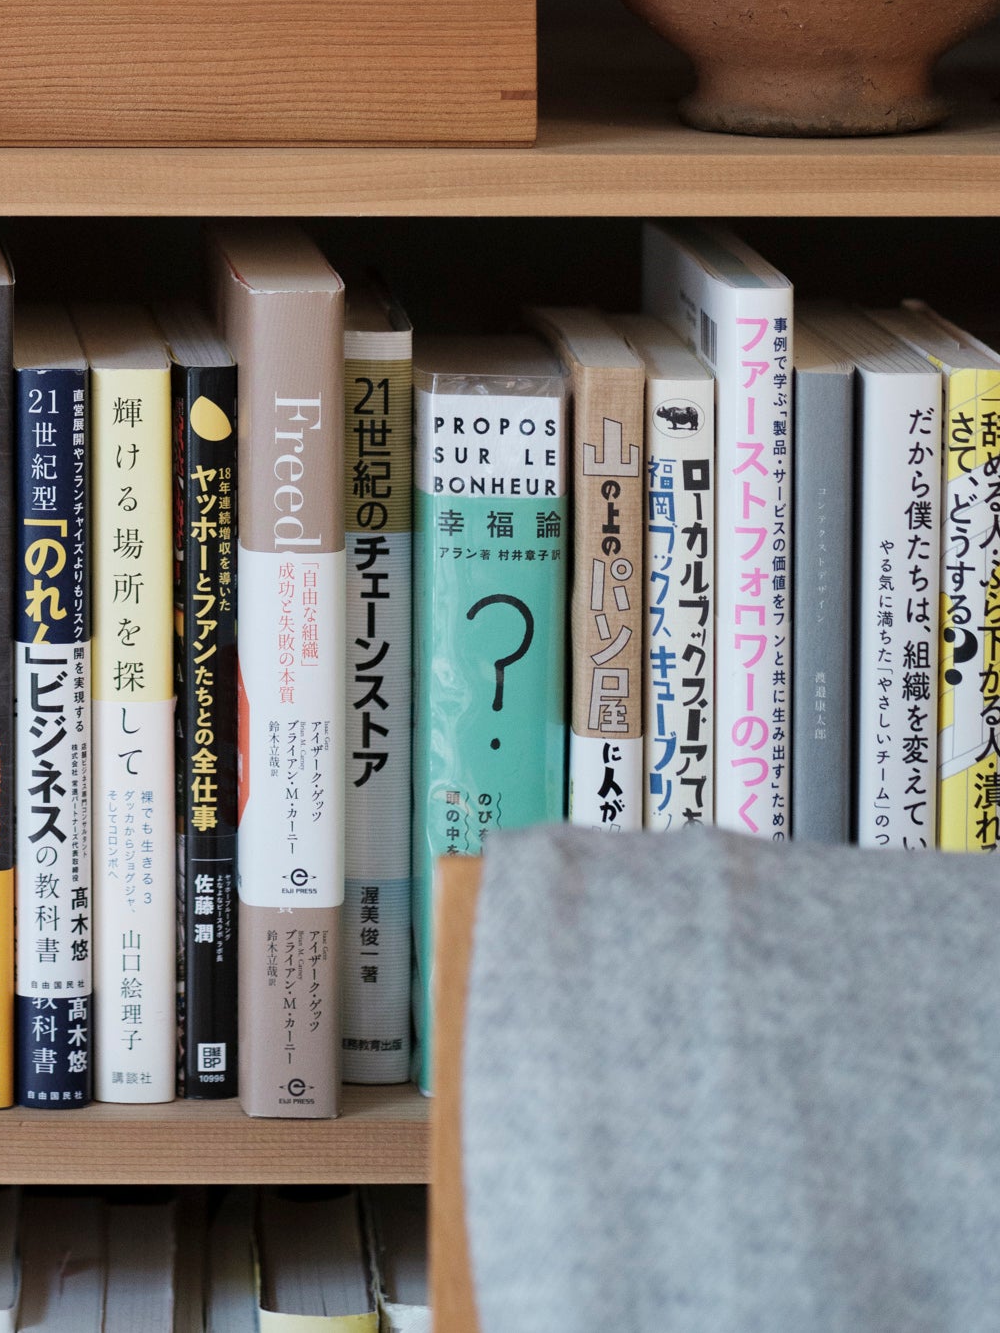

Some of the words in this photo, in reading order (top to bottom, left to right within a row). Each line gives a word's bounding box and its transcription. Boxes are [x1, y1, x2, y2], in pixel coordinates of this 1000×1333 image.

[274, 391, 322, 551] Freed
[433, 446, 491, 465] SUR
[525, 449, 556, 466] LE
[434, 417, 556, 436] PROPOS
[433, 476, 557, 496] BONHEUR
[438, 510, 562, 538] 幸福論
[111, 396, 145, 775] 輝ける場所を探して
[218, 468, 231, 612] 18年連続増収を導いた
[352, 378, 394, 788] 21世紀のチェーンストア
[731, 317, 771, 834] ファーストフォロワーのつく
[190, 464, 219, 832] ヤッホーとファンたちとの全仕事
[277, 562, 295, 705] 成功と失敗の本質
[300, 562, 320, 667] 「自由な組織」
[267, 721, 280, 767] 鈴木立哉
[286, 720, 300, 854] ブライアン・M・カーニー
[310, 720, 325, 822] アイザーク・ゲッツ
[106, 790, 120, 880] そしてコロンボへ
[123, 790, 137, 913] ダッカからジョグジャ、
[194, 874, 215, 915] 佐藤
[194, 924, 215, 943] 潤
[30, 978, 85, 990] 自由国民社
[121, 930, 144, 1051] 山口絵理子
[266, 930, 278, 977] 鈴木立哉
[283, 929, 297, 1064] ブライアン・M・カーニー
[308, 930, 322, 1032] アイザーク・ゲッツ
[26, 1090, 83, 1101] 自由国民社
[111, 1071, 152, 1085] 講談社
[199, 1073, 226, 1084] 10996
